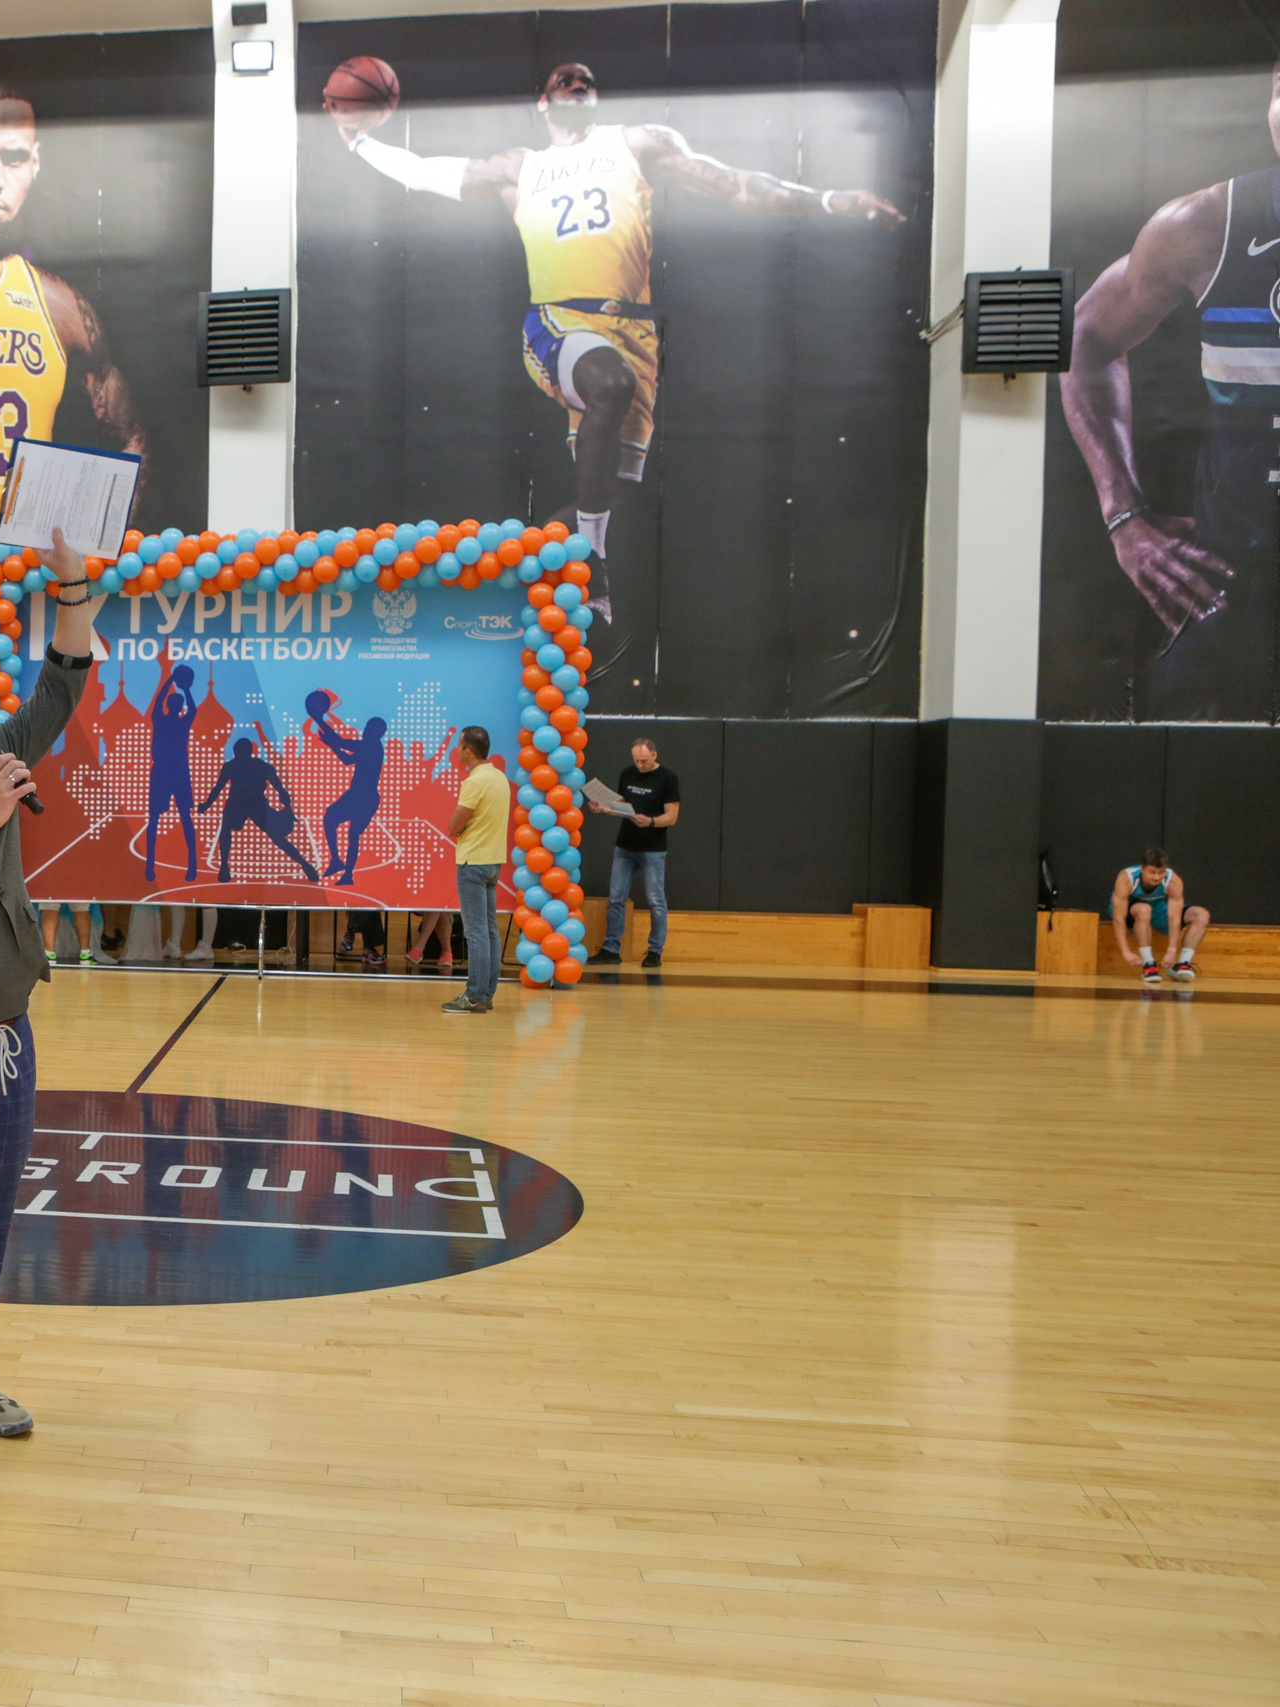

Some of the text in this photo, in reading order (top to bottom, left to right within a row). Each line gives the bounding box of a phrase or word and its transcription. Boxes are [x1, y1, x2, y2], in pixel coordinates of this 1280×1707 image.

[552, 187, 611, 238] 23
[118, 588, 352, 634] ТУРНИР
[118, 637, 353, 661] ПО БАСКЕТБОЛУ
